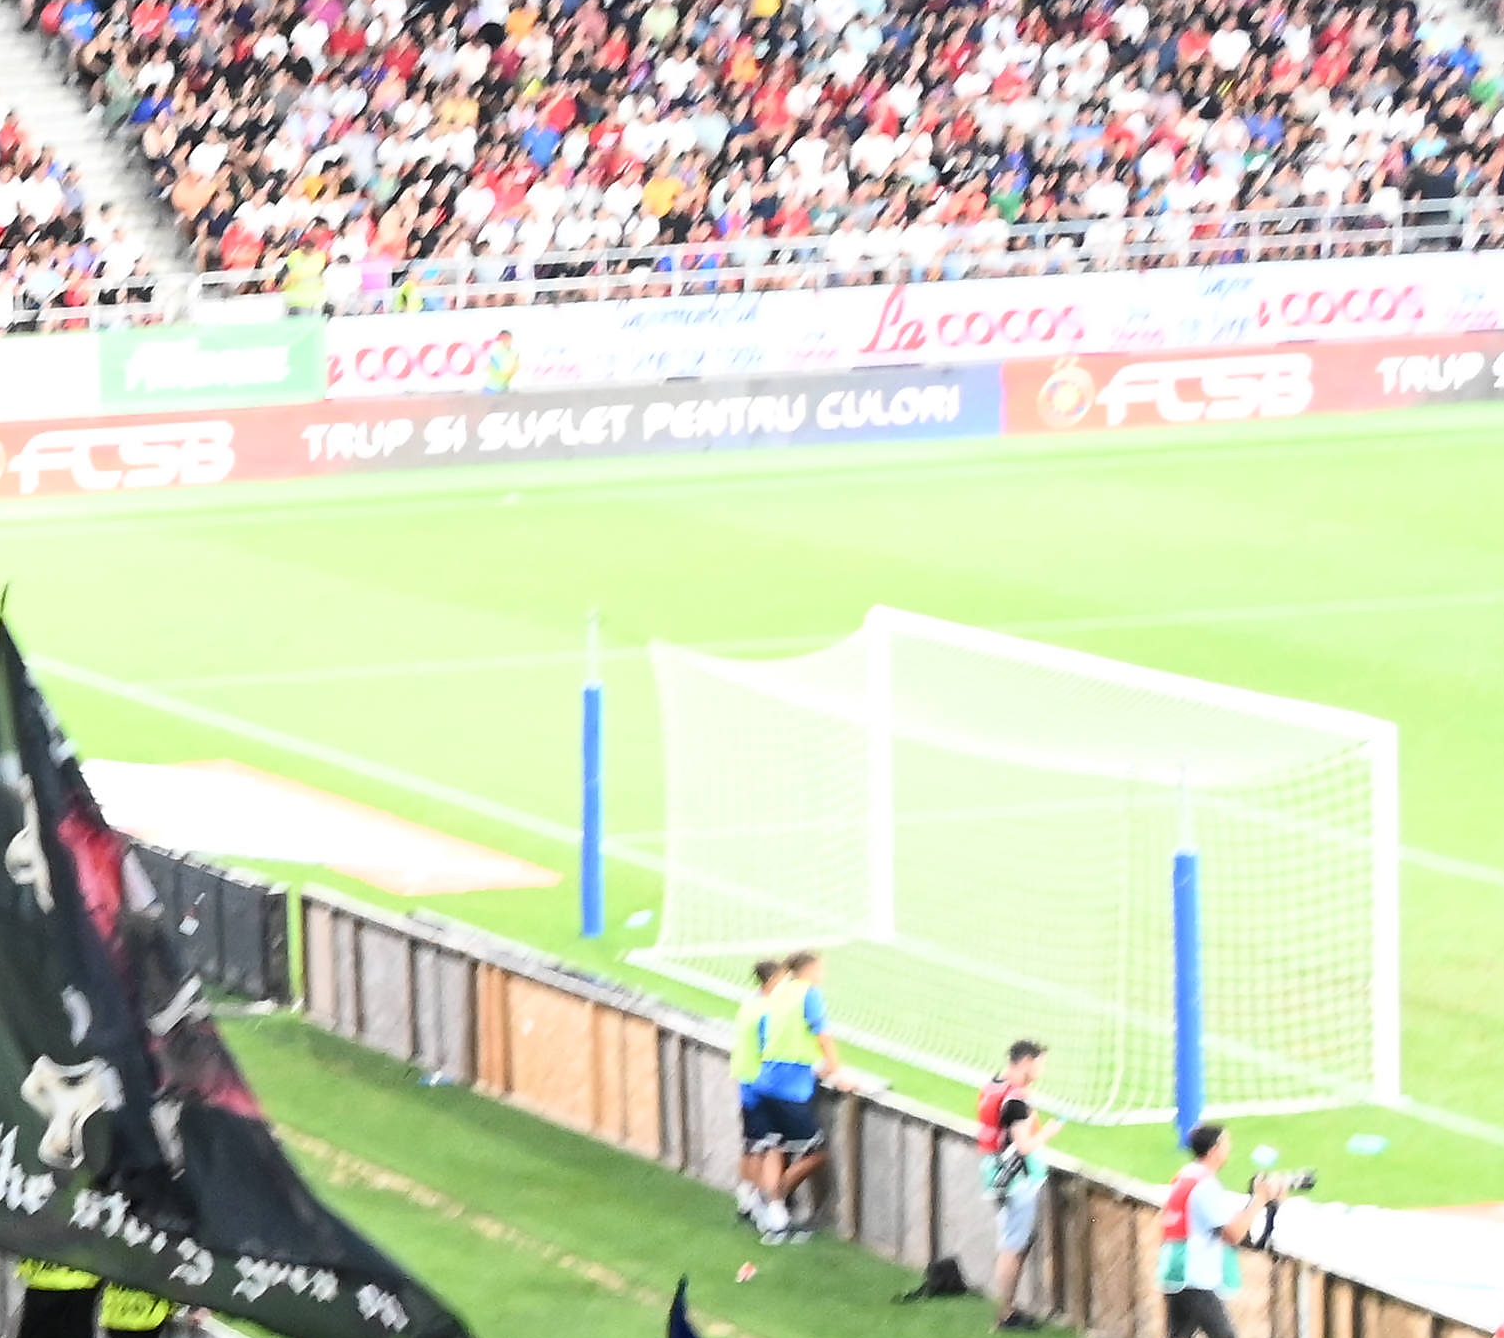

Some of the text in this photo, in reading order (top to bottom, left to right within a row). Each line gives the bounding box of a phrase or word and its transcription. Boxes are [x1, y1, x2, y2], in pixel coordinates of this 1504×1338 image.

[1095, 353, 1315, 427] FCSB
[1375, 351, 1484, 396] TRUP
[6, 420, 237, 495] FCSB
[300, 417, 415, 462] TRUP
[478, 402, 634, 452] SUFLET
[641, 390, 808, 441] PENTRU
[815, 382, 961, 431] CULORI
